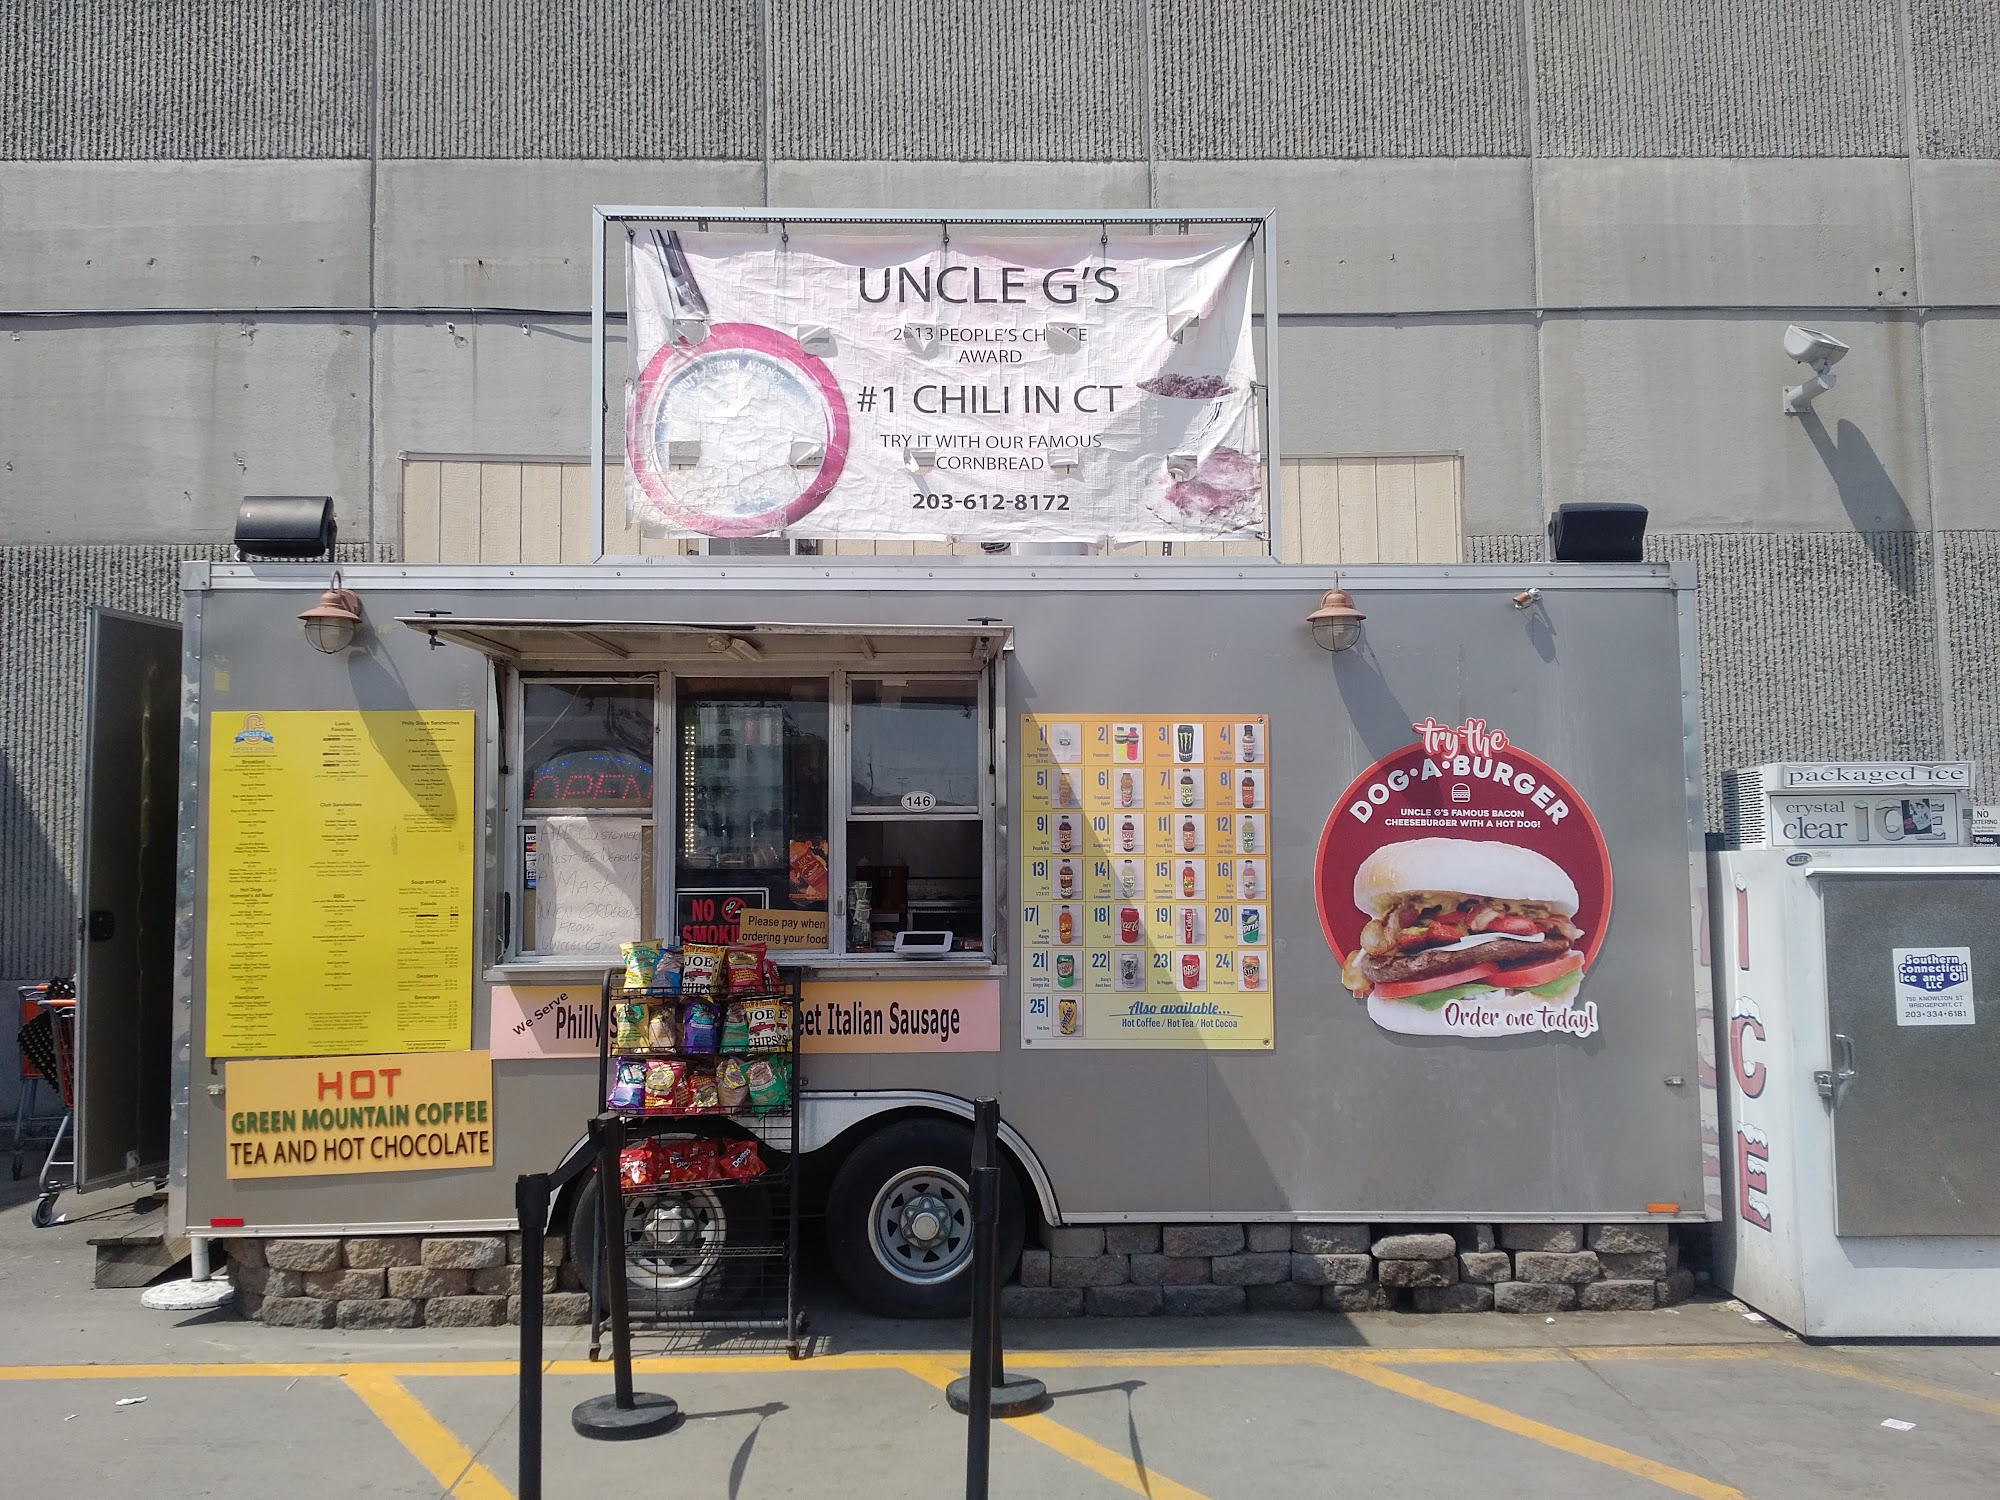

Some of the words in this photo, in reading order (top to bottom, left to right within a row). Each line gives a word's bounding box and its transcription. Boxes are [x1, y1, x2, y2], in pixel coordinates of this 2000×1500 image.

[859, 266, 1027, 304] UNCLE
[1042, 266, 1120, 304] G'S
[940, 328, 1017, 342] PEOPLE'S
[1022, 328, 1089, 342] CHCE
[958, 349, 1023, 363] AWARD
[857, 385, 894, 414] #1
[913, 385, 1010, 414] CHILI
[1025, 385, 1060, 413] IN
[1073, 385, 1123, 413] CT
[880, 434, 913, 448] TRY
[917, 434, 931, 448] IT
[935, 434, 981, 449] WITH
[985, 435, 1024, 450] OUR
[1028, 434, 1102, 449] FAMOUS
[936, 456, 1044, 471] CORNBREAD
[912, 493, 1070, 511] 203-612-8172
[1039, 727, 1044, 740] 1
[1098, 727, 1105, 740] 2
[1159, 727, 1165, 741] 3
[1220, 727, 1226, 741] 4
[1415, 718, 1460, 757] try
[1459, 719, 1505, 755] the
[1037, 772, 1044, 786] 5
[1098, 772, 1105, 786] 6
[1160, 772, 1167, 786] 7
[1220, 772, 1227, 786] 8
[1789, 767, 1915, 785] packaged
[1928, 769, 1964, 780] ice
[906, 796, 931, 807] 146
[1786, 801, 1845, 814] crystal
[1400, 808, 1431, 817] UNCLE
[1433, 809, 1448, 817] G'S
[1451, 809, 1489, 817] FAMOUS
[1491, 810, 1524, 818] BACON
[1976, 810, 1989, 818] NO
[1037, 817, 1044, 831] 9
[1093, 817, 1105, 831] 10
[1158, 817, 1167, 831] 11
[1217, 817, 1228, 831] 12
[1385, 819, 1457, 827] CHEESEBURGER
[1460, 819, 1483, 827] WITH
[1486, 819, 1495, 827] A
[1496, 819, 1515, 827] HOT
[1516, 820, 1541, 828] DOG!
[1783, 817, 1848, 839] clear
[1033, 862, 1044, 876] 13
[1094, 862, 1106, 876] 14
[1156, 862, 1168, 876] 15
[1217, 862, 1229, 876] 16
[692, 899, 714, 921] NO
[1024, 908, 1035, 922] 17
[1094, 908, 1106, 922] 18
[1156, 908, 1168, 922] 19
[1214, 908, 1229, 922] 20
[748, 916, 779, 926] Please
[781, 919, 799, 929] pay
[801, 918, 825, 929] when
[742, 932, 780, 943] ordering
[782, 934, 804, 943] your
[807, 933, 827, 944] food
[685, 956, 713, 967] JOE
[1033, 953, 1044, 967] 21
[1092, 953, 1106, 967] 22
[1154, 954, 1168, 968] 23
[1216, 954, 1230, 968] 24
[1906, 955, 1959, 964] Southern
[1899, 963, 1967, 973] Connecticut
[1900, 973, 1917, 982] Ice
[1922, 973, 1945, 982] and
[1949, 972, 1967, 981] Oil
[1030, 999, 1045, 1013] 25
[1129, 1001, 1158, 1015] Also
[512, 1019, 534, 1035] We
[534, 992, 569, 1020] Serve
[1445, 1003, 1499, 1027] Order
[1505, 1013, 1535, 1027] one
[1536, 1004, 1595, 1033] today!
[556, 1005, 601, 1047] Philly
[828, 1002, 883, 1035] Italian
[889, 1002, 960, 1042] Sausage
[1122, 1019, 1134, 1027] Hot
[1136, 1018, 1160, 1028] Coffee
[1167, 1019, 1179, 1027] Hot
[1181, 1019, 1194, 1028] Tea
[1201, 1019, 1213, 1028] Hot
[1215, 1019, 1238, 1028] Cocoa
[1730, 872, 1772, 1232] ICE
[318, 1068, 402, 1100] HOT
[231, 1110, 296, 1134] GREEN
[302, 1105, 410, 1131] MOUNTAIN
[415, 1100, 488, 1126] COFFEE
[230, 1142, 267, 1166] TEA
[273, 1139, 317, 1163] AND
[323, 1137, 365, 1162] HOT
[370, 1130, 489, 1159] CHOCOLATE
